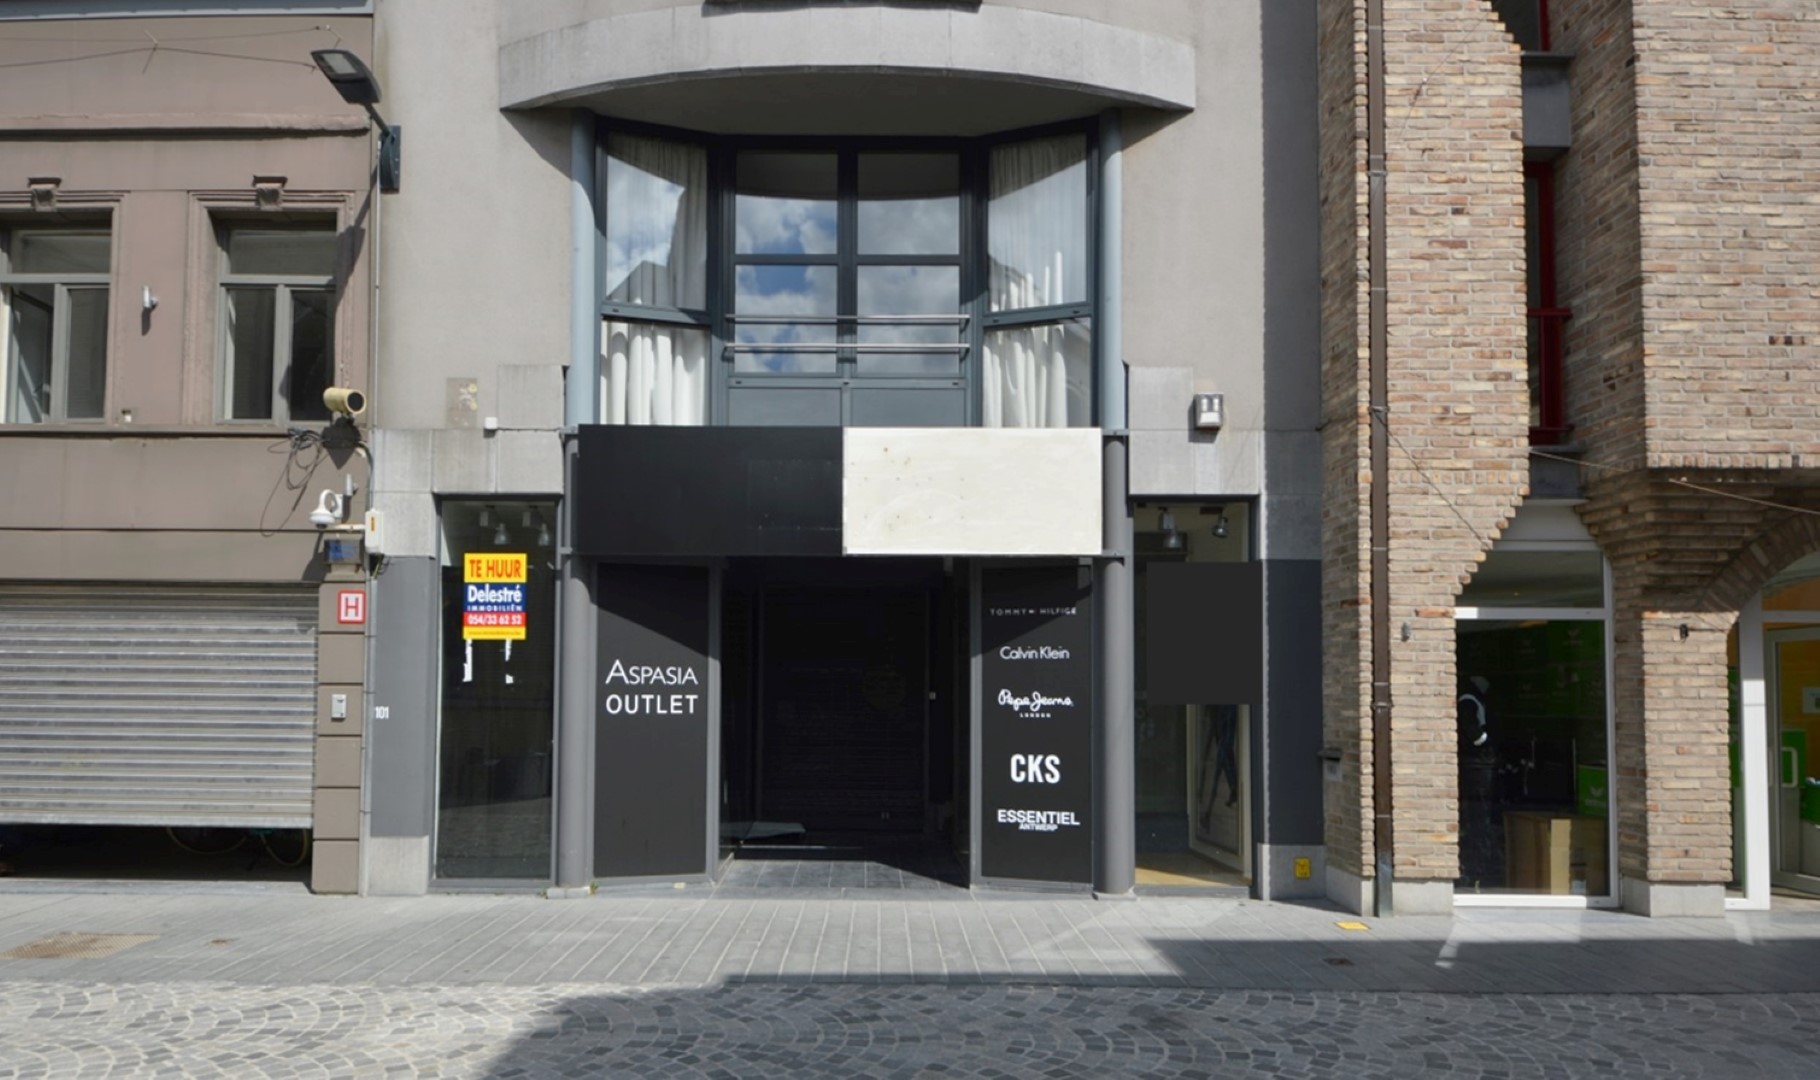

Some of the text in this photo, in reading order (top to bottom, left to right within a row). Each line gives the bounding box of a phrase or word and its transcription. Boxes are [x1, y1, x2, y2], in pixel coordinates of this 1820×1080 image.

[469, 559, 522, 577] TE HUUR
[468, 583, 522, 602] Delestré
[344, 596, 359, 617] H
[989, 608, 1027, 616] TOMMY
[1000, 646, 1070, 660] Calvin Klein
[606, 694, 699, 715] OUTLET
[998, 688, 1073, 711] Pepe Jeans
[374, 706, 389, 719] 101
[1010, 753, 1061, 784] CKS
[997, 809, 1080, 825] ESSENTIEL
